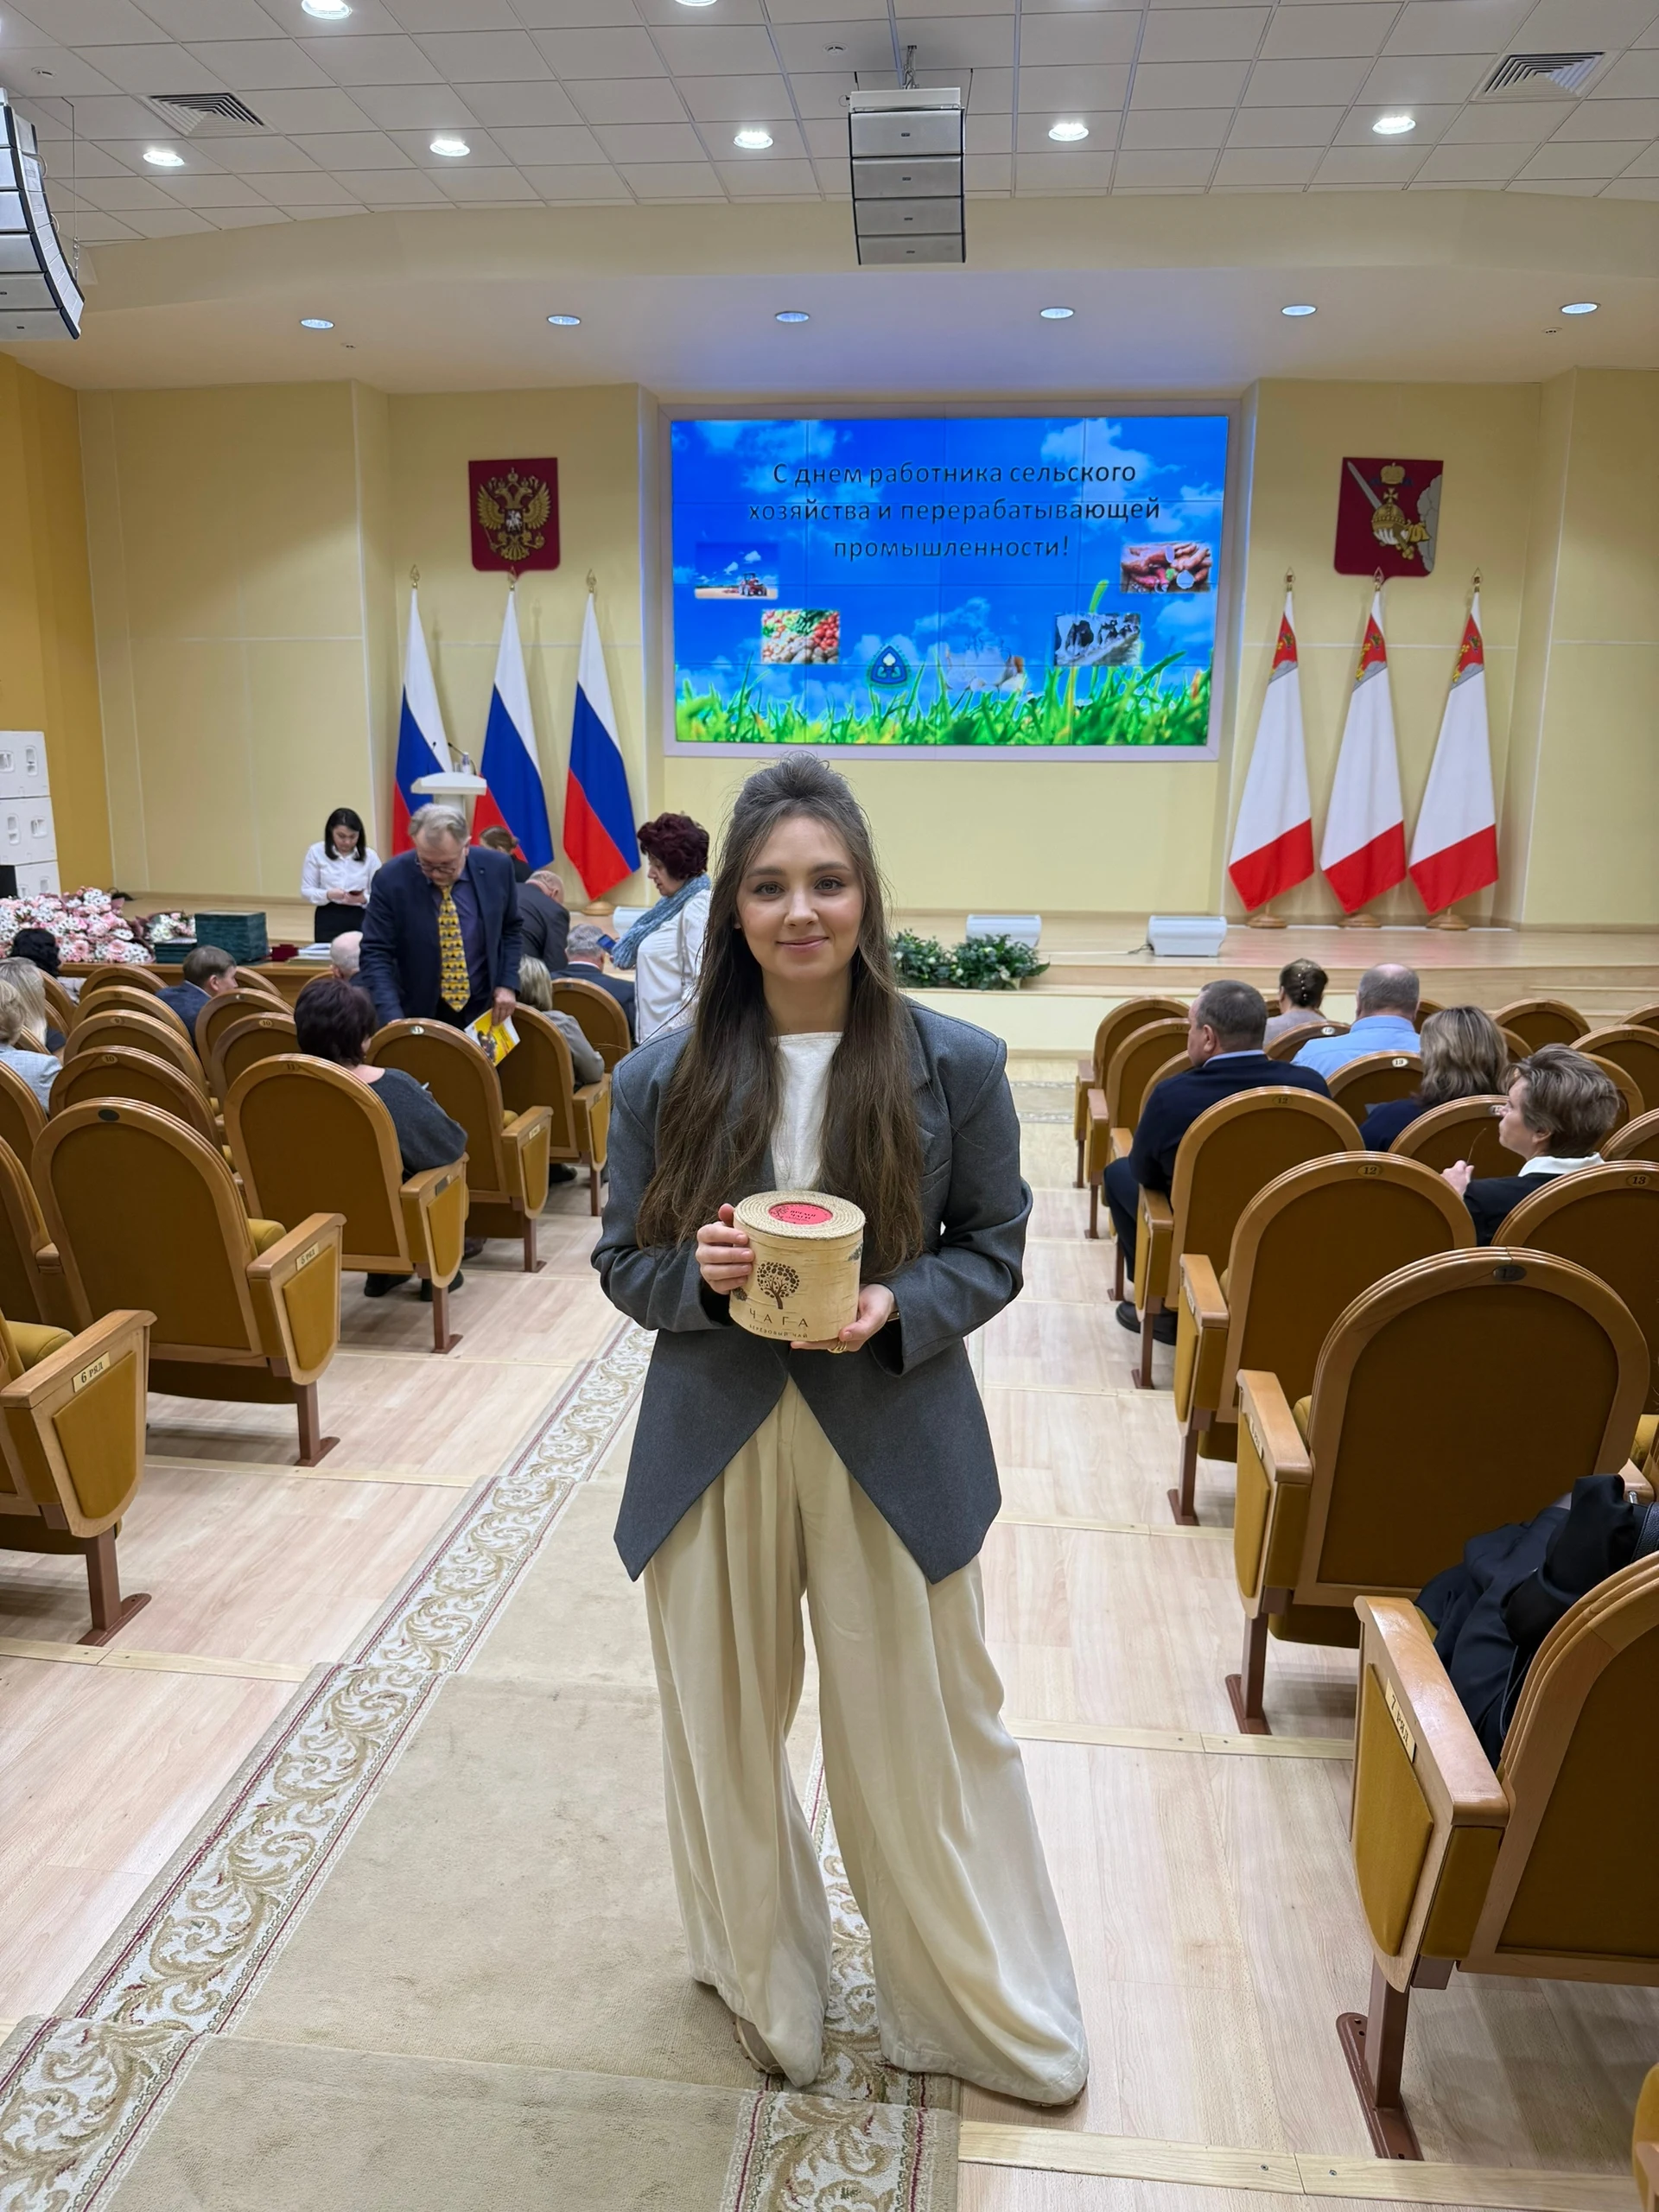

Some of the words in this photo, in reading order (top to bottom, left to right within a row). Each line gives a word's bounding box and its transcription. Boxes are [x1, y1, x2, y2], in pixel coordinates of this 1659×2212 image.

[773, 463, 788, 484] С
[795, 467, 862, 488] днем
[870, 461, 1001, 488] работника
[1010, 466, 1136, 482] сельского
[749, 499, 870, 520] хозяйства
[879, 504, 892, 520] и
[902, 497, 1160, 524] перерабатывающей
[835, 536, 1069, 562] промышленности!
[1632, 1176, 1646, 1185] 13
[749, 1307, 809, 1328] ЧАГА
[80, 1371, 87, 1383] 6
[1391, 1694, 1396, 1711] 7
